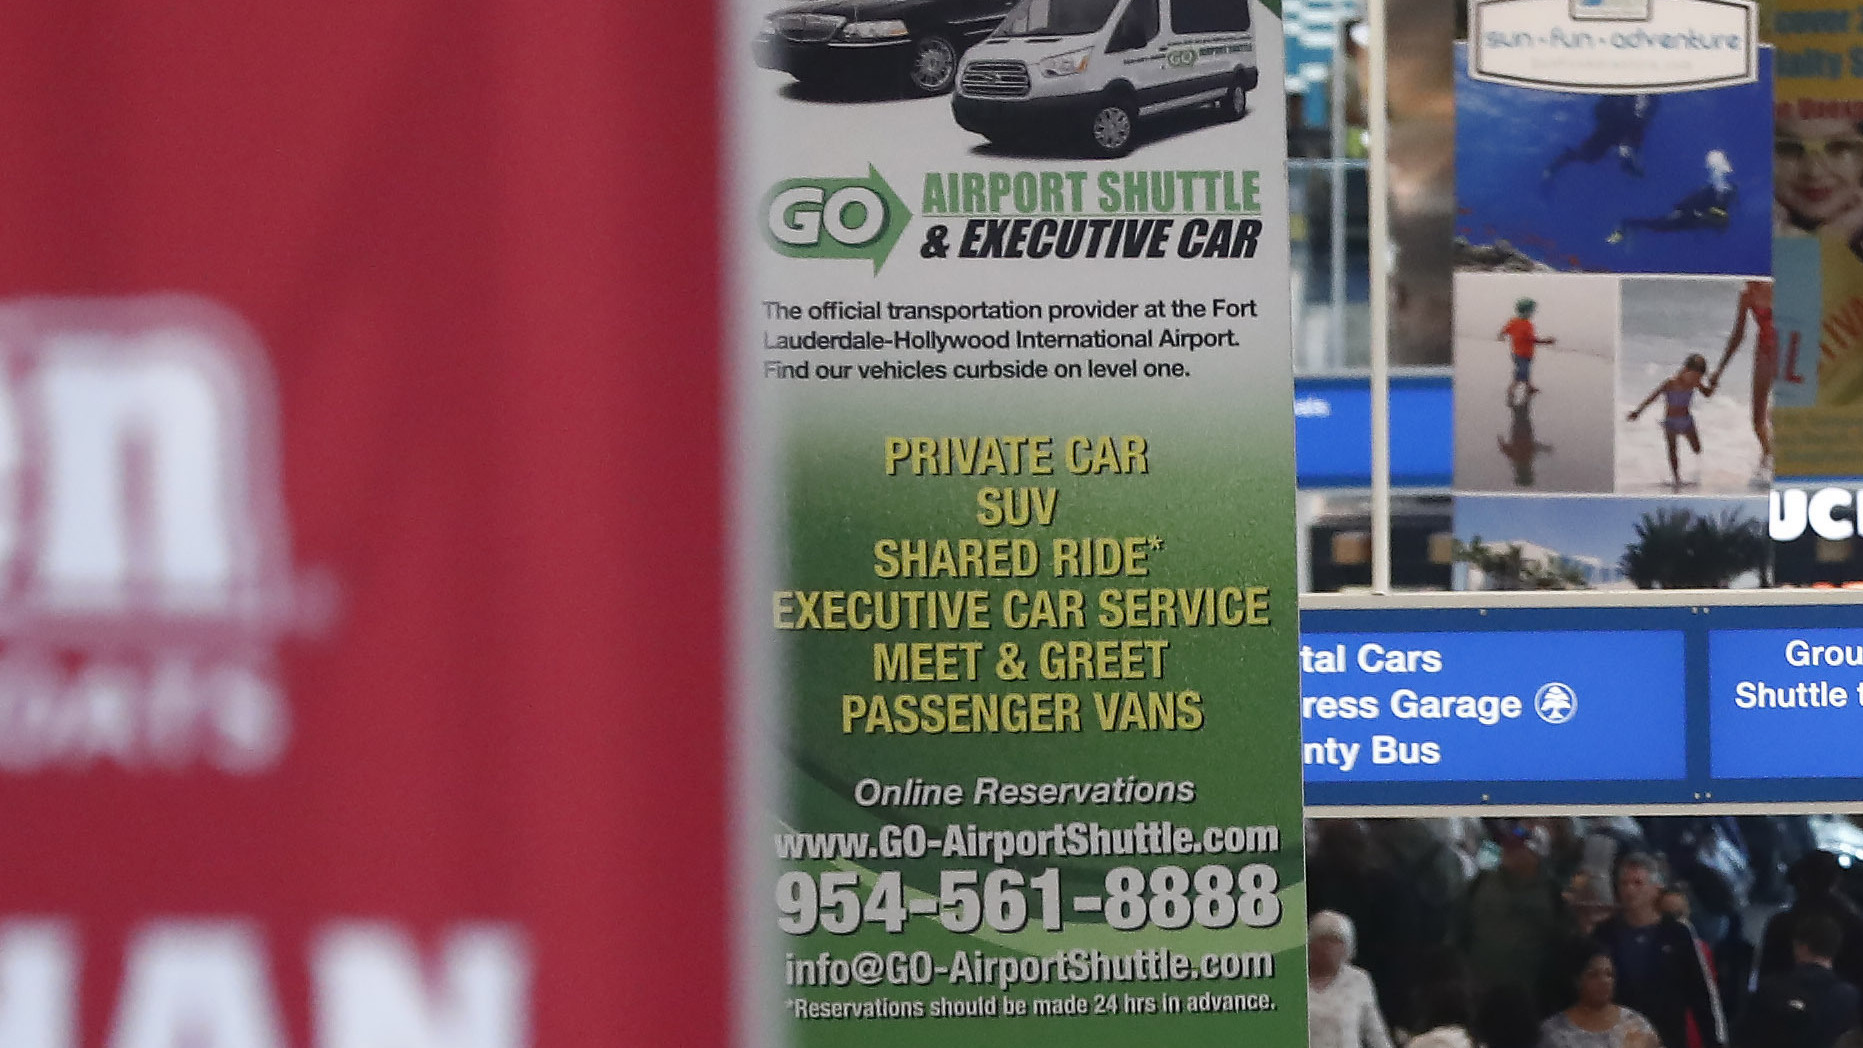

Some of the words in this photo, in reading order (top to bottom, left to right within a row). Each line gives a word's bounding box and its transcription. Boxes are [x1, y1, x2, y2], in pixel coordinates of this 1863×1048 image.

[1486, 30, 1532, 46] sun
[1611, 28, 1742, 50] adventure
[923, 170, 1087, 213] AIRPORT
[1098, 169, 1261, 212] SHUTTLE
[768, 186, 886, 247] GO
[920, 223, 951, 258] &
[959, 218, 1173, 258] EXECUTIVE
[1178, 218, 1263, 258] CAR
[763, 301, 801, 319] The
[809, 301, 881, 320] official
[888, 301, 1042, 324] transportation
[1049, 300, 1139, 323] provider
[1144, 302, 1165, 319] at
[1172, 300, 1206, 319] the
[1212, 300, 1257, 319] Fort
[764, 330, 1009, 353] Lauderdale-Hollywood
[1016, 330, 1153, 349] International
[1159, 329, 1239, 353] Airport.
[764, 361, 809, 379] Find
[815, 365, 853, 379] our
[859, 360, 947, 379] vehicles
[954, 360, 1048, 379] curbside
[1056, 364, 1083, 379] on
[1087, 359, 1137, 378] level
[1143, 363, 1190, 379] one.
[885, 436, 1053, 475] PRIVATE
[1065, 436, 1148, 474] CAR
[976, 487, 1058, 526] SUV
[875, 538, 1040, 578] SHARED
[773, 590, 991, 630] EXECUTIVE
[1003, 589, 1086, 628] CAR
[1100, 586, 1270, 627] SERVICE
[874, 642, 984, 681] MEET
[995, 644, 1027, 680] &
[1040, 640, 1168, 679] GREET
[1300, 644, 1346, 673] tal
[1357, 643, 1443, 673] Cars
[843, 693, 1082, 734] PASSENGER
[1094, 690, 1204, 732] VANS
[1302, 695, 1380, 719] ress
[1390, 688, 1523, 726] Garage
[1735, 680, 1848, 710] Shuttle
[1303, 737, 1361, 772] nty
[1372, 735, 1442, 765] Bus
[855, 777, 963, 807] Online
[974, 776, 1195, 804] Reservations
[775, 822, 1280, 863] www.GO-AirportShuttle.com
[776, 865, 1282, 934] 954-561-8888
[785, 950, 1275, 990] info@GO-AirportShuttle.com
[930, 996, 997, 1018] should
[1003, 997, 1026, 1017] be
[1033, 995, 1087, 1016] made
[1093, 995, 1118, 1015] 24
[1123, 995, 1156, 1014] hrs
[1161, 994, 1181, 1014] in
[1187, 993, 1277, 1013] advance.
